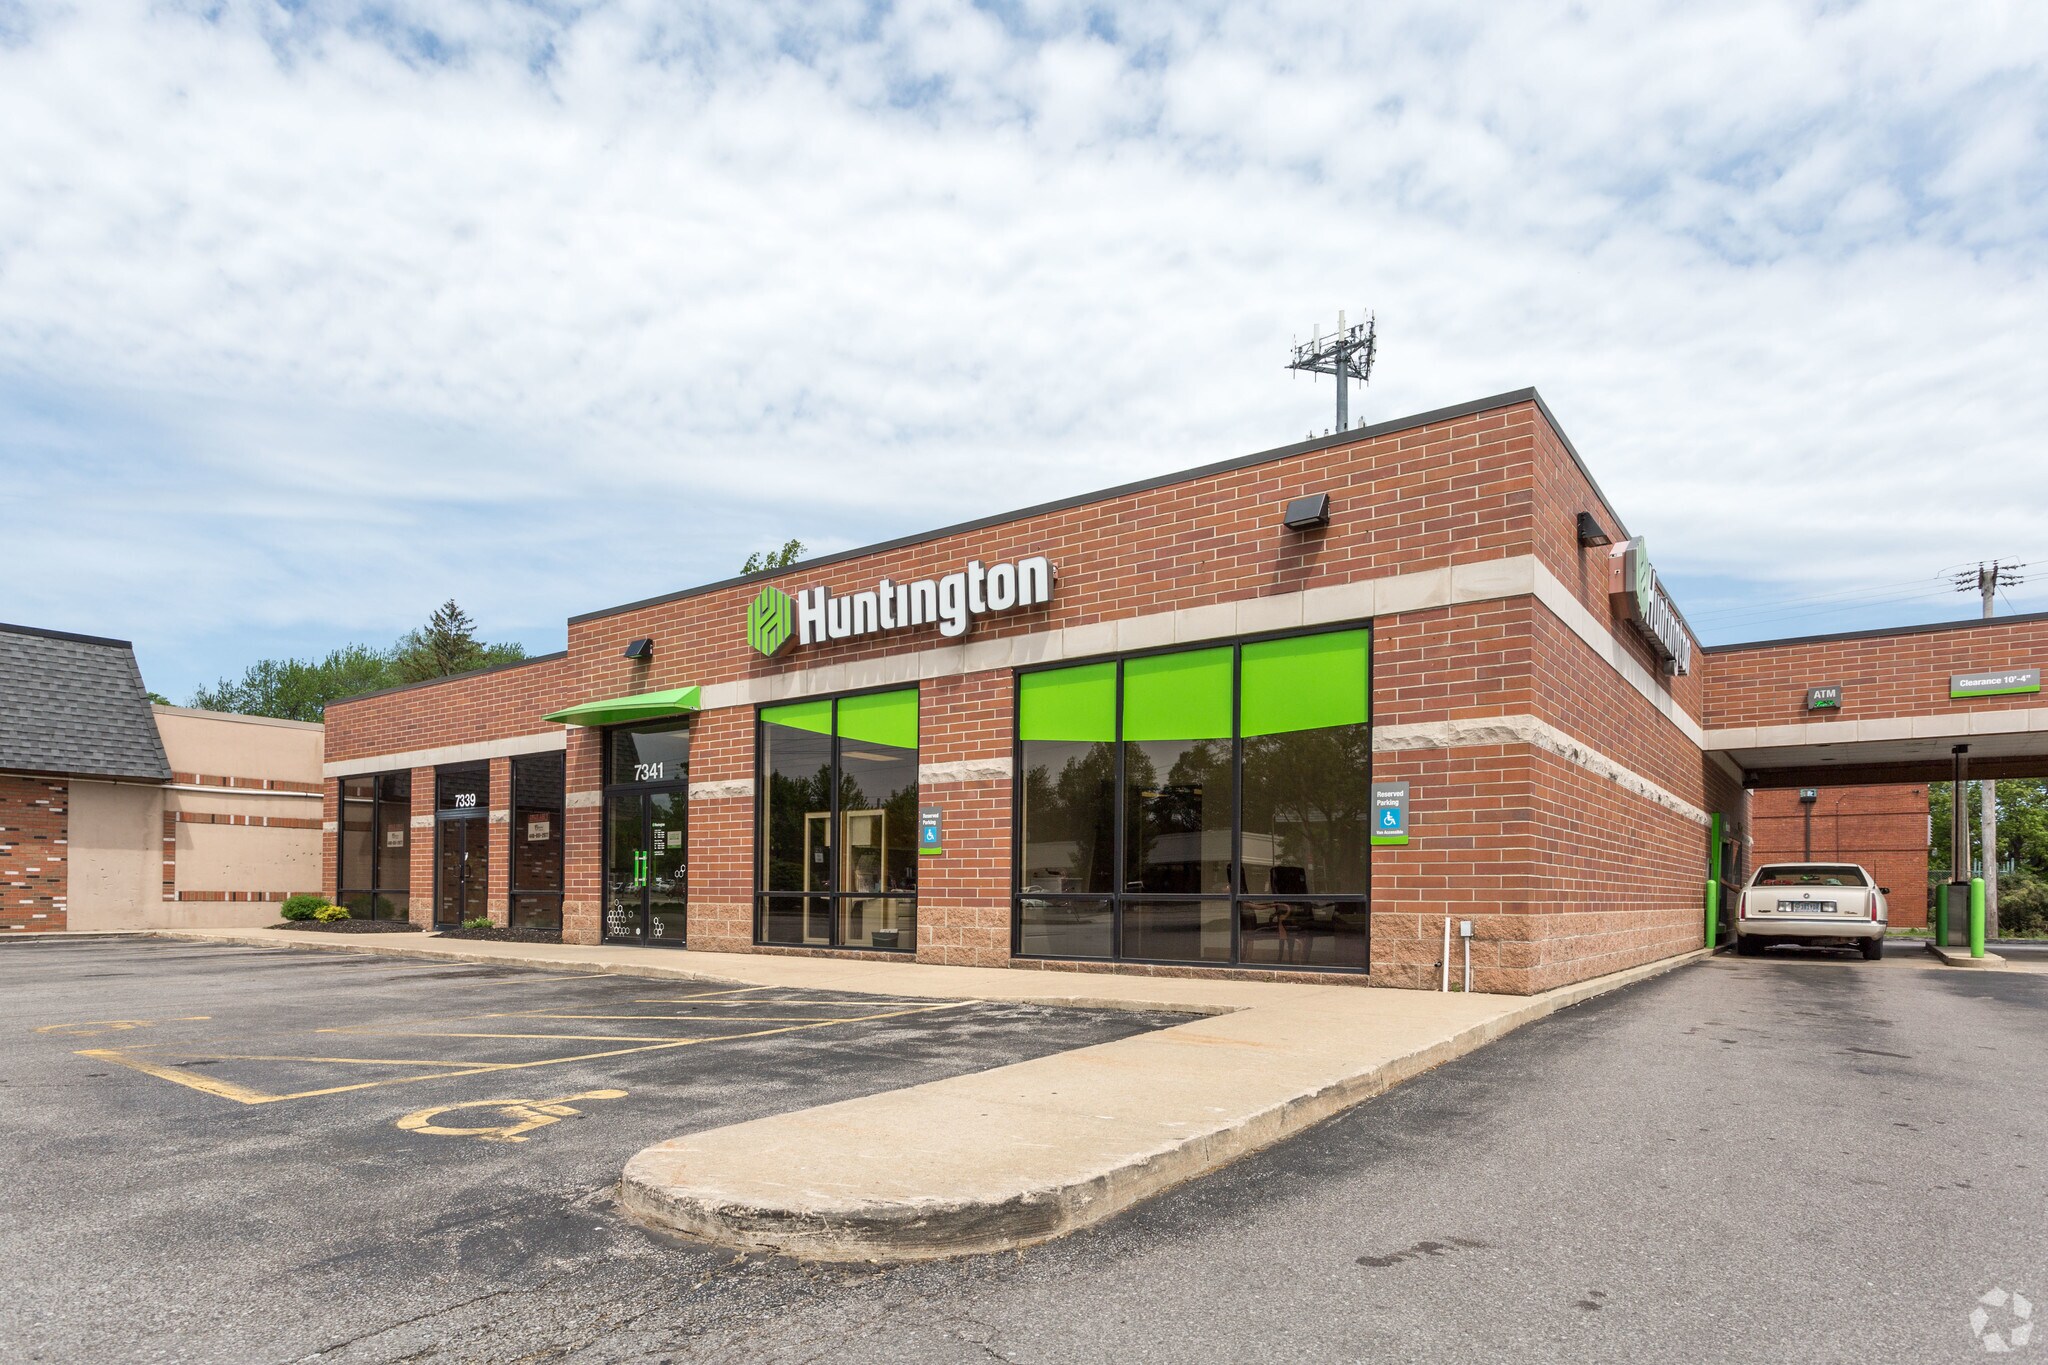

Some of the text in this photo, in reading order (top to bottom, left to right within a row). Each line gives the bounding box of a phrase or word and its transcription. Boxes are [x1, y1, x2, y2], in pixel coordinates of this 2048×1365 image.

[798, 556, 1052, 645] Huntington
[1960, 678, 2002, 687] Clearance
[1813, 689, 1836, 699] ATM
[634, 762, 664, 781] 7341
[1376, 790, 1404, 798] Reserved
[455, 793, 476, 808] 7339
[1376, 799, 1399, 807] Parking
